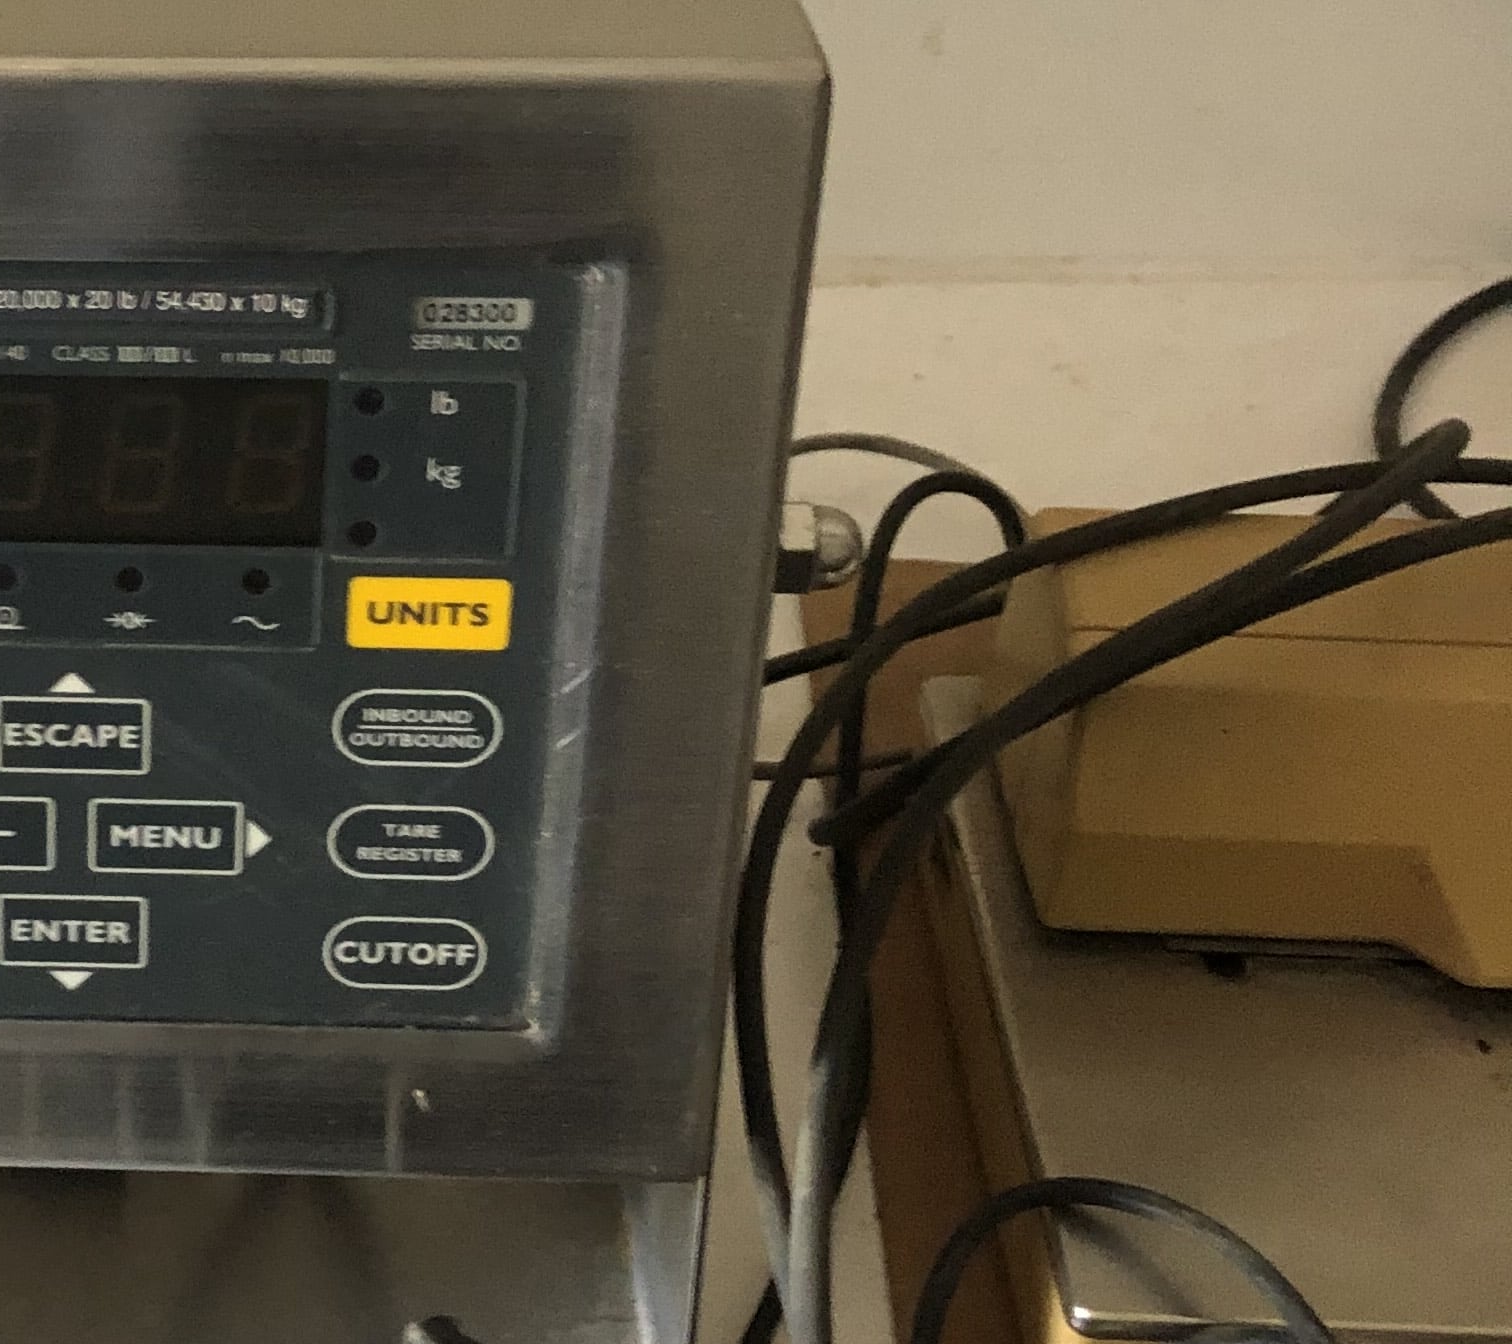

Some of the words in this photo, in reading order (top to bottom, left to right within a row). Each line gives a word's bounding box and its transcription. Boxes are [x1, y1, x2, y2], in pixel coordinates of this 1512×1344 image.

[66, 293, 80, 308] x
[85, 290, 113, 310] 20
[229, 296, 246, 312] x
[252, 293, 278, 313] 10
[280, 294, 309, 318] kg
[409, 333, 479, 351] SERIAL
[430, 389, 459, 416] lb
[425, 457, 464, 489] kg
[365, 601, 492, 627] UNITS
[362, 708, 474, 725] INBOUND
[1, 723, 142, 751] ESCAPE
[348, 730, 485, 750] OUTBOUND
[109, 825, 223, 850] MENU
[382, 823, 442, 840] TARE
[354, 846, 463, 864] REGISTER
[8, 919, 133, 947] ENTER
[333, 939, 479, 966] CUTOFF
